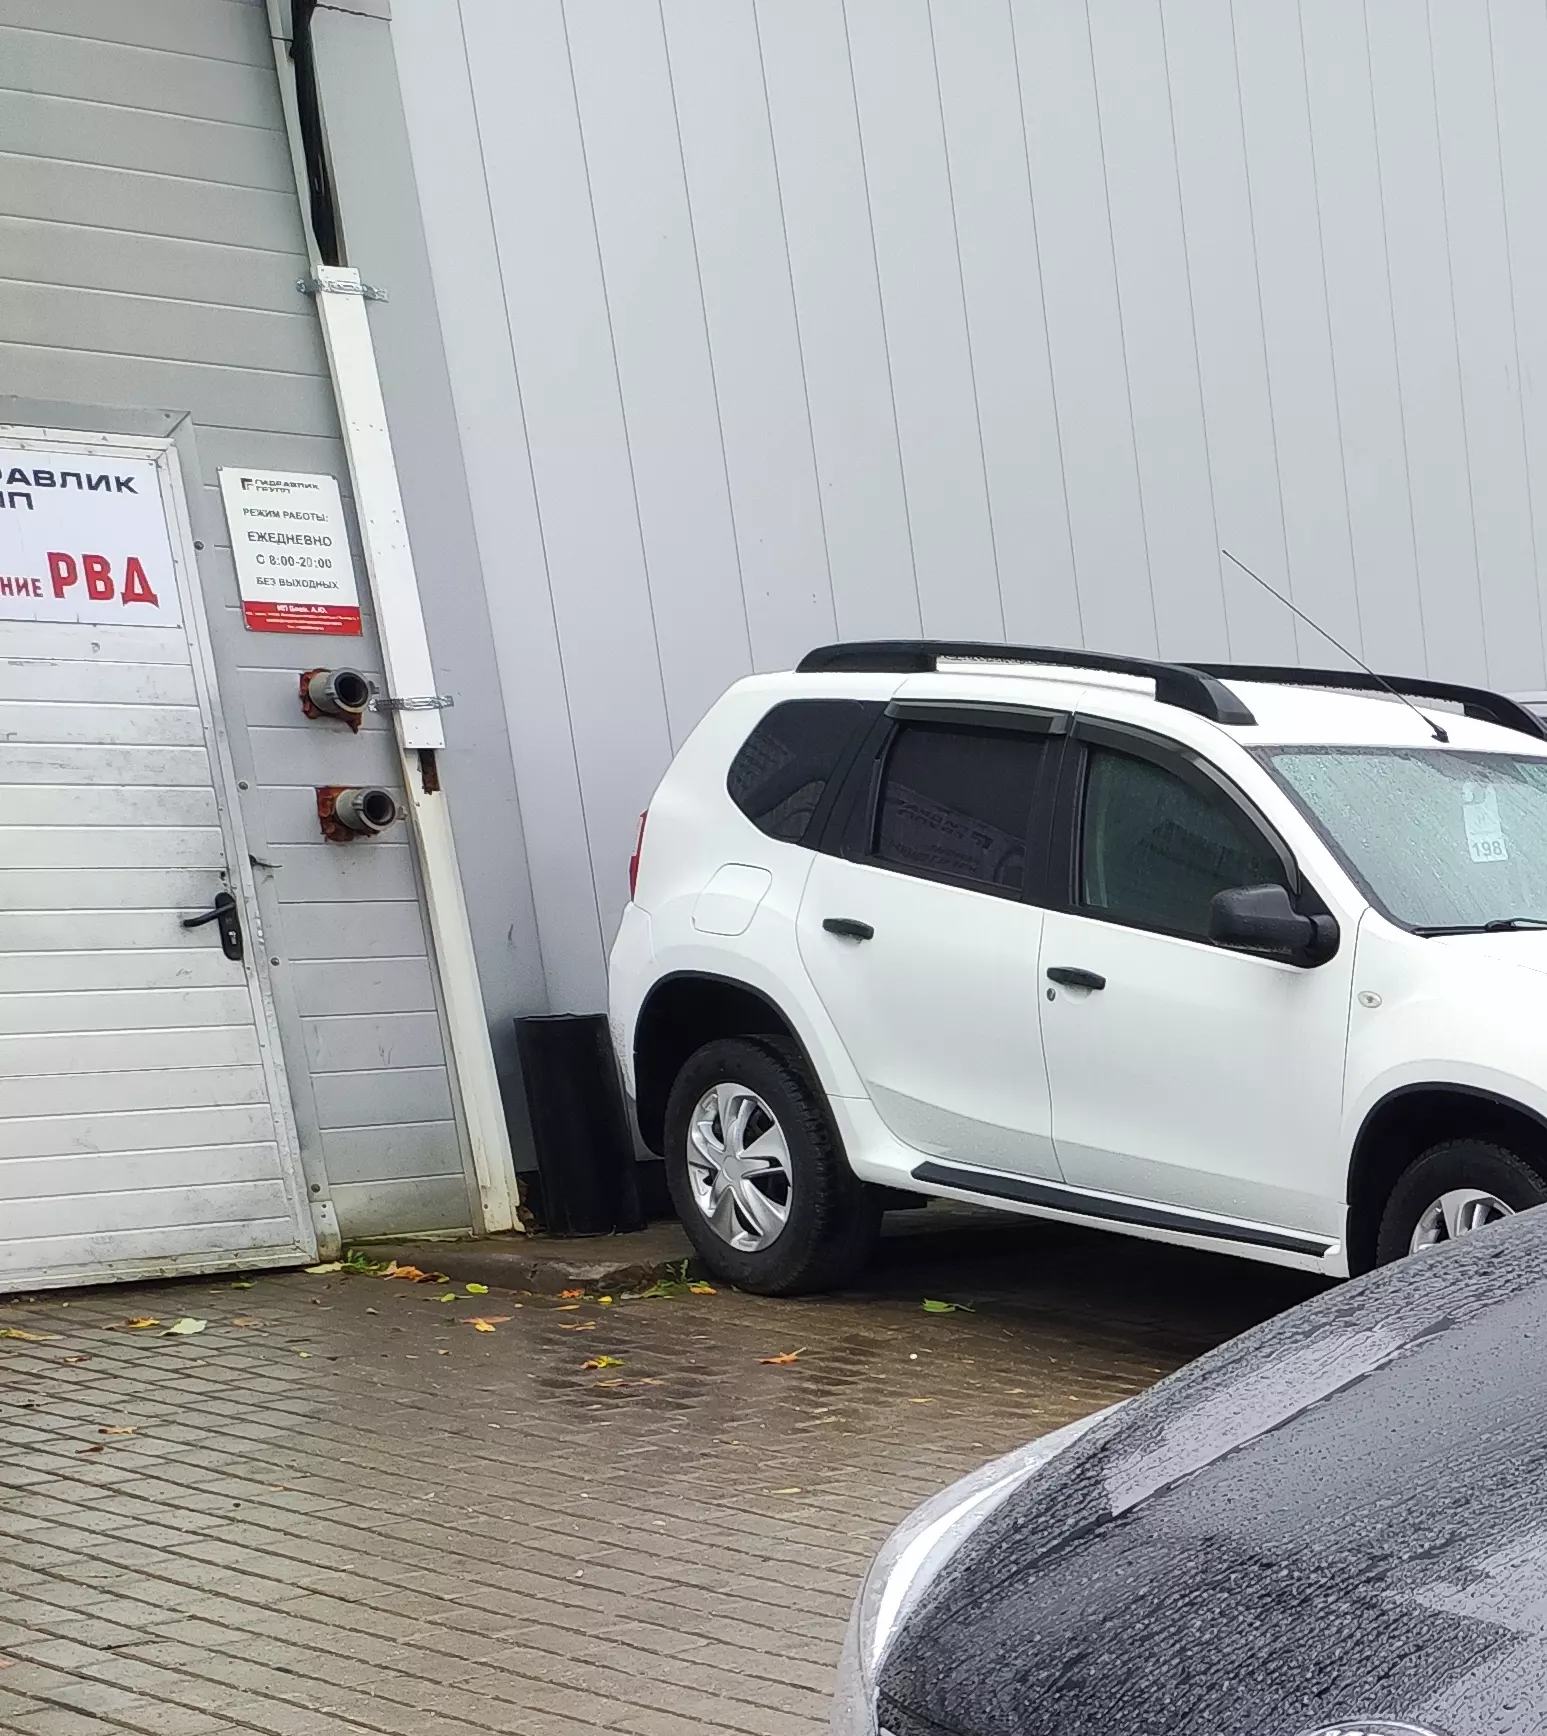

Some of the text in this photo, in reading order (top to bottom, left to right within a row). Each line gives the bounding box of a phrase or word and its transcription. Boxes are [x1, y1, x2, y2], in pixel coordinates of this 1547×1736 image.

[0, 467, 139, 494] АВЛИК
[243, 508, 328, 522] РЕЖИМ РАБОТЫ:
[248, 531, 332, 547] ЕЖЕДНЕВНО
[256, 554, 265, 564] С
[47, 552, 160, 608] РВД
[256, 577, 339, 589] БЕЗ ВЫХОДНЫХ
[1472, 841, 1502, 857] 198
